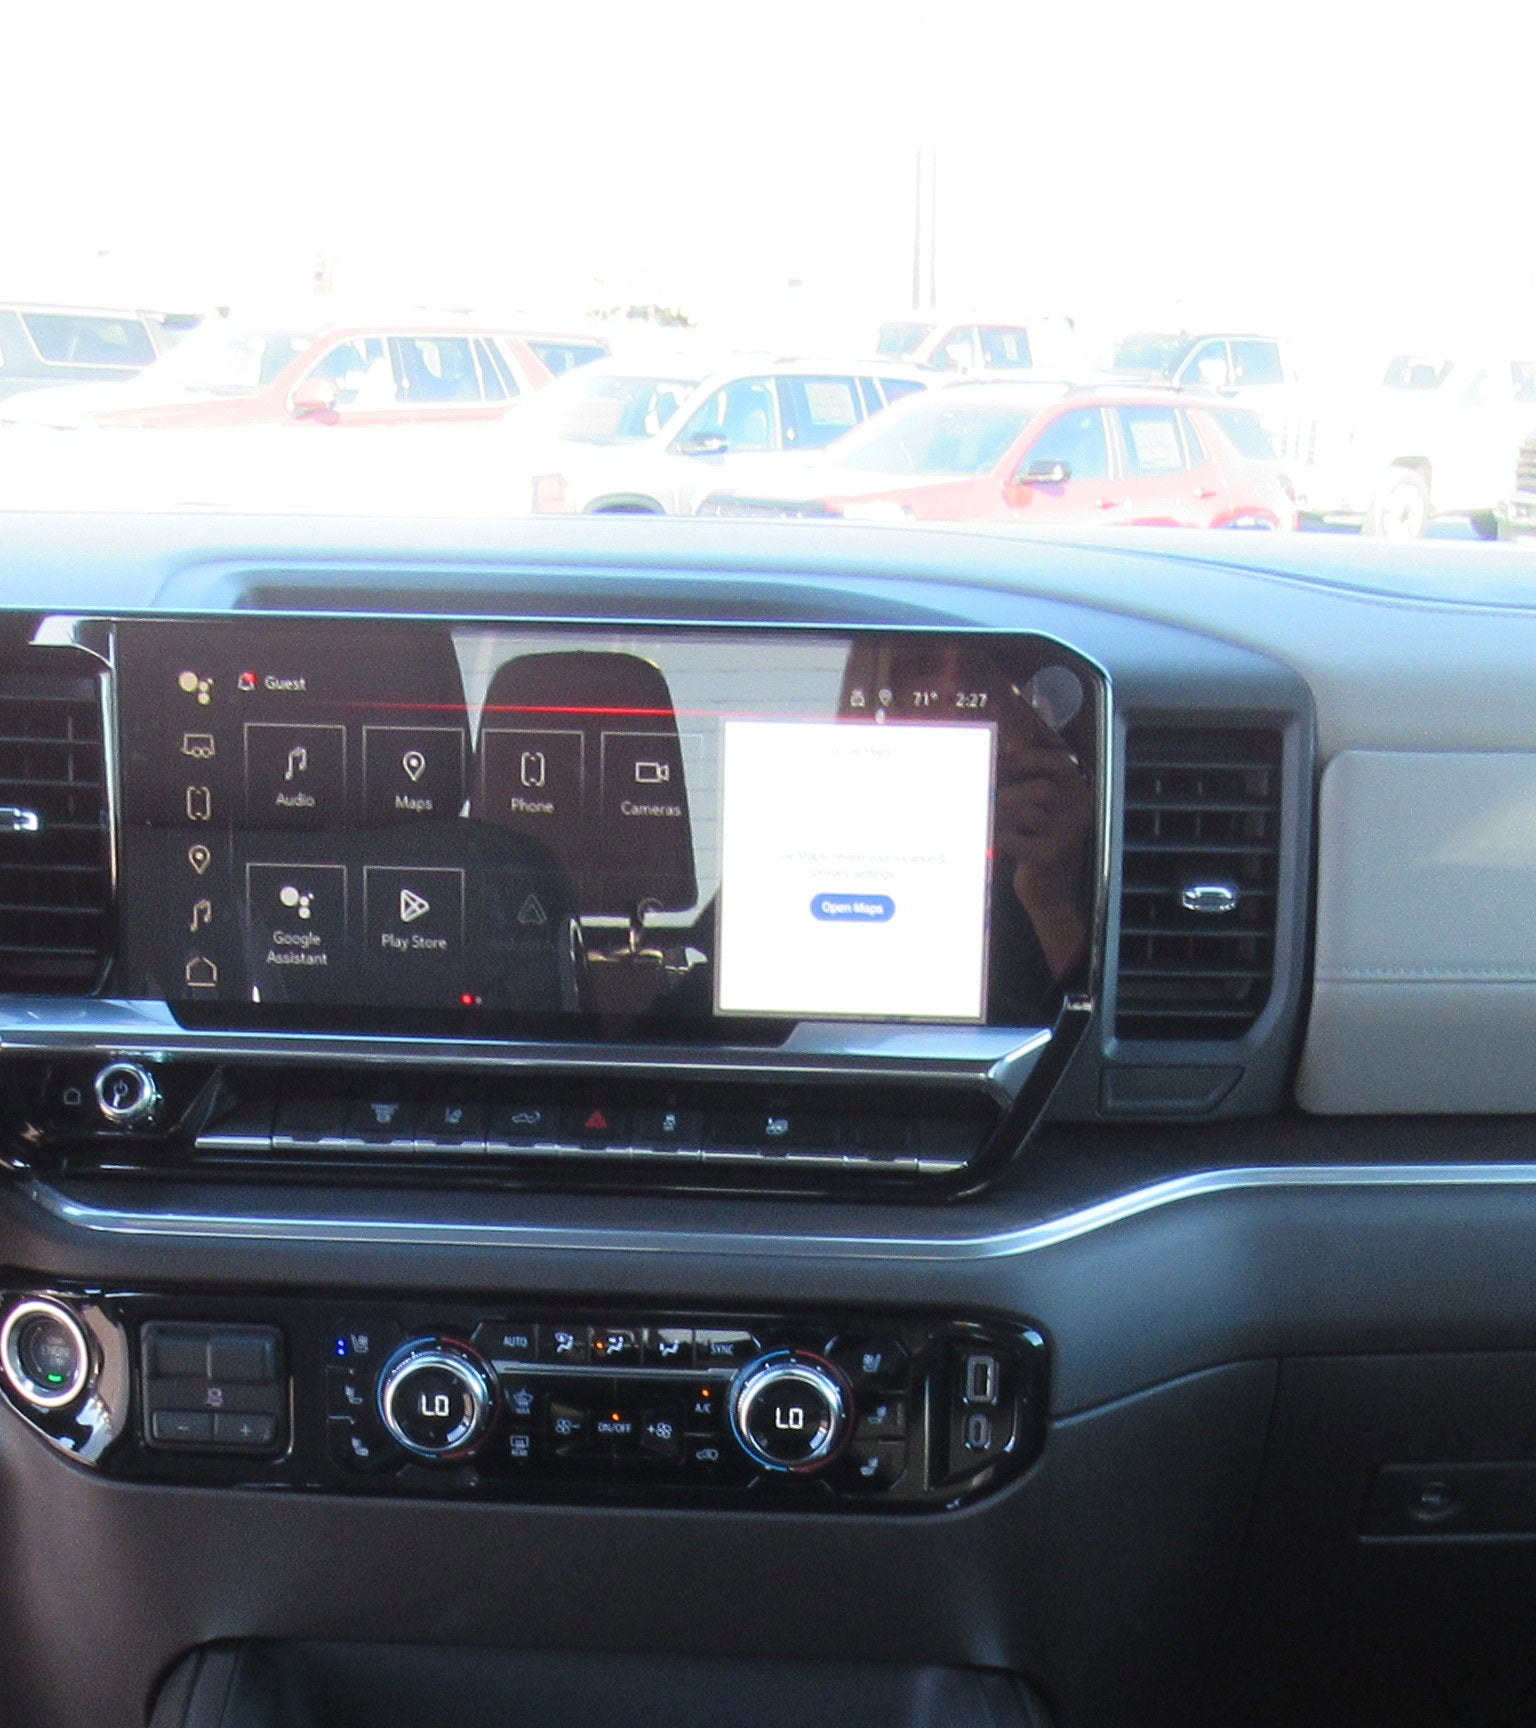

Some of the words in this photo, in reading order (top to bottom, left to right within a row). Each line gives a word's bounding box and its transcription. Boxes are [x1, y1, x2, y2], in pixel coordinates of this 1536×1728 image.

[264, 675, 307, 691] Guest
[912, 690, 939, 708] 71°
[955, 691, 989, 709] 2:27
[275, 791, 316, 807] Audio
[395, 794, 433, 812] Maps
[511, 797, 555, 814] Phone
[620, 800, 682, 817] Cameras
[820, 901, 852, 915] Open
[853, 902, 884, 917] Maps
[273, 930, 322, 949] Google
[381, 933, 409, 951] Play
[412, 934, 448, 950] Store
[267, 950, 329, 967] Assistant
[503, 1336, 528, 1348] AUTO
[710, 1344, 735, 1356] SYNC
[420, 1394, 450, 1418] LO
[694, 1403, 712, 1414] A/C
[775, 1407, 804, 1430] LO
[597, 1422, 632, 1434] ON/OFF
